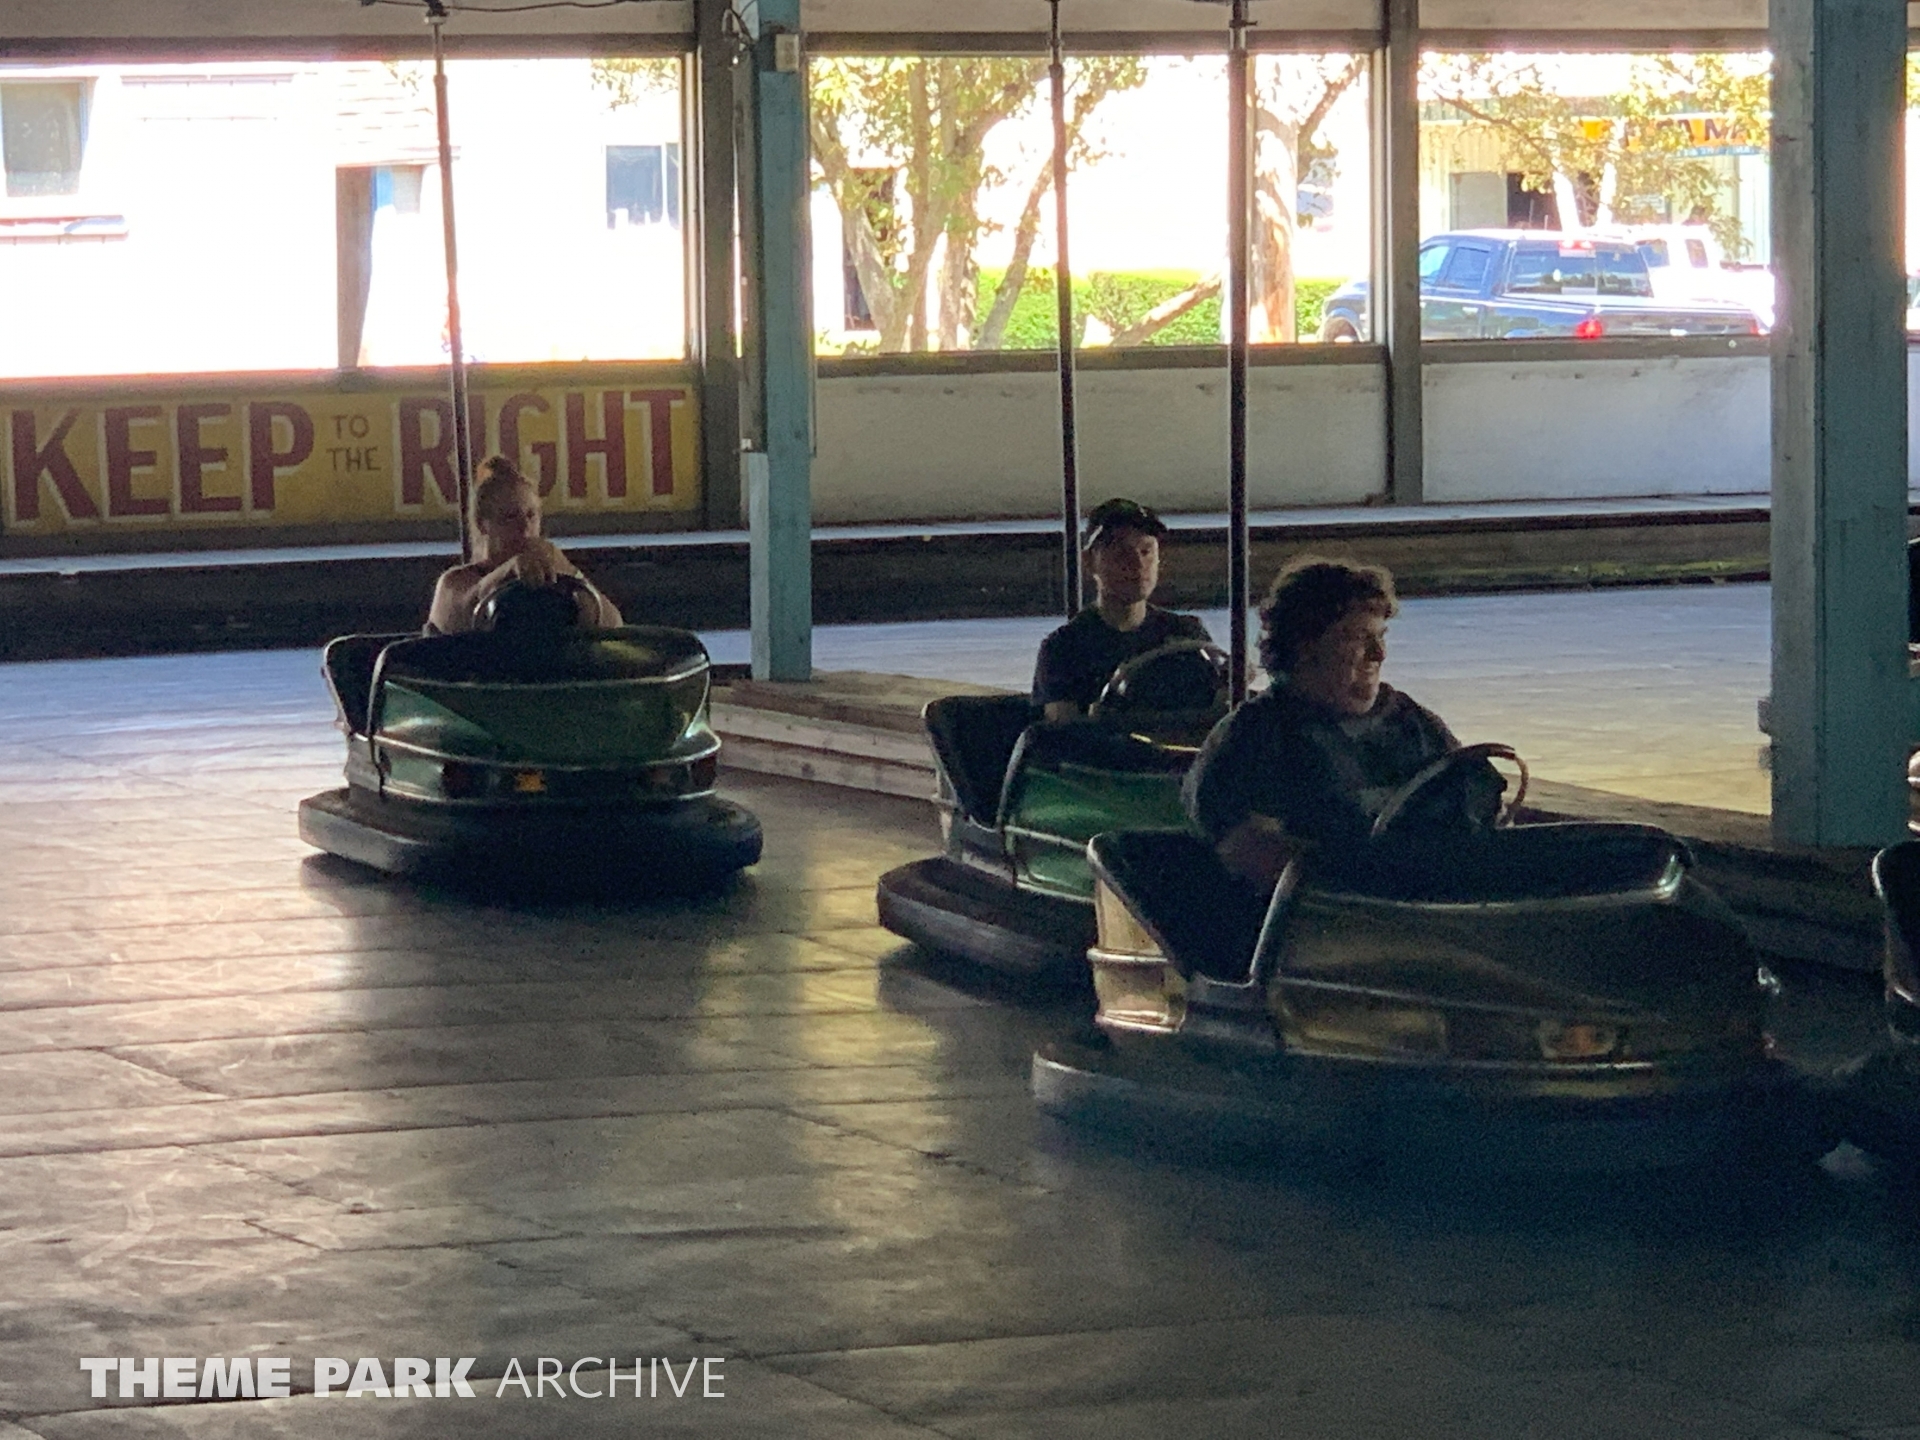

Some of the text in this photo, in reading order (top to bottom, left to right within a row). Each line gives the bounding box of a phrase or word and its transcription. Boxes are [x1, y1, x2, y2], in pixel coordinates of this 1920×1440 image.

[9, 390, 686, 522] KEEP TO THE RIGHT
